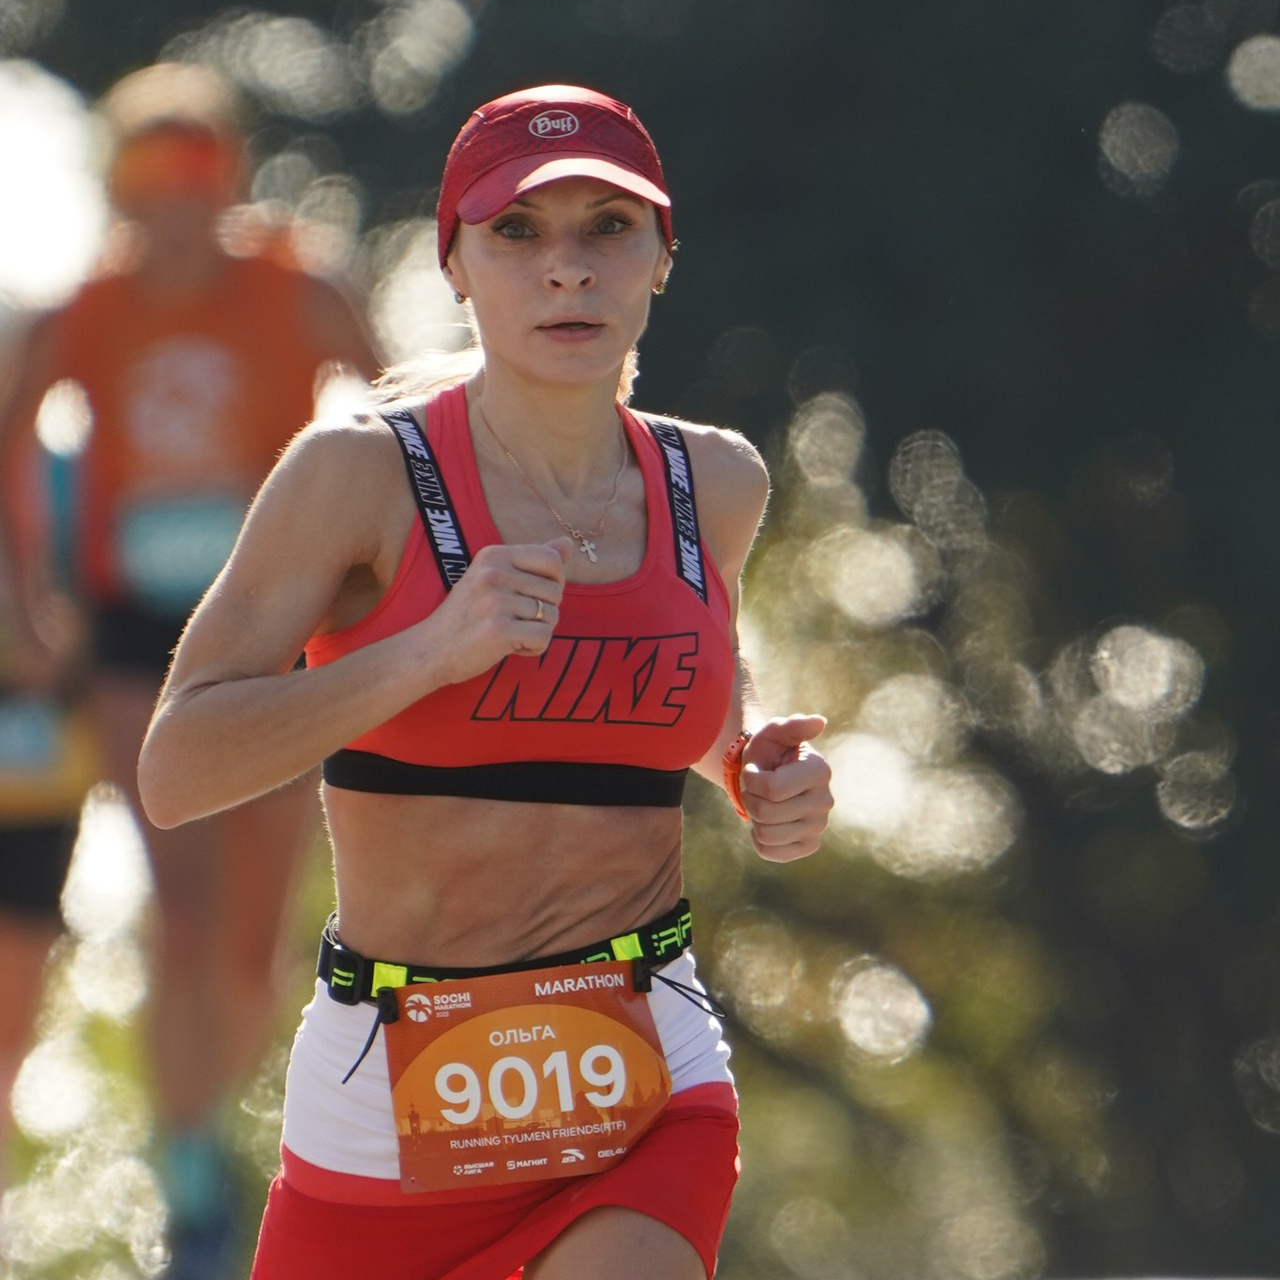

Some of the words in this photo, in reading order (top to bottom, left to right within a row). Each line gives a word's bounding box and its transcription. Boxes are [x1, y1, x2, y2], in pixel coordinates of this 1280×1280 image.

[535, 117, 572, 134] Buff
[394, 420, 430, 460] NIKE
[410, 459, 446, 505] NIKE
[663, 442, 690, 494] NIKE
[426, 508, 464, 555] NIKE
[672, 488, 696, 540] NIKE
[679, 535, 703, 589] NIKE
[470, 632, 699, 727] NIKE
[433, 992, 471, 1004] SOCHI
[535, 974, 625, 996] MARATHON
[434, 1003, 472, 1011] MARATHON
[489, 1025, 556, 1046] ОЛЬГА
[434, 1044, 626, 1125] 9019
[450, 1136, 501, 1150] RUNNING
[503, 1130, 551, 1145] TYUMEN
